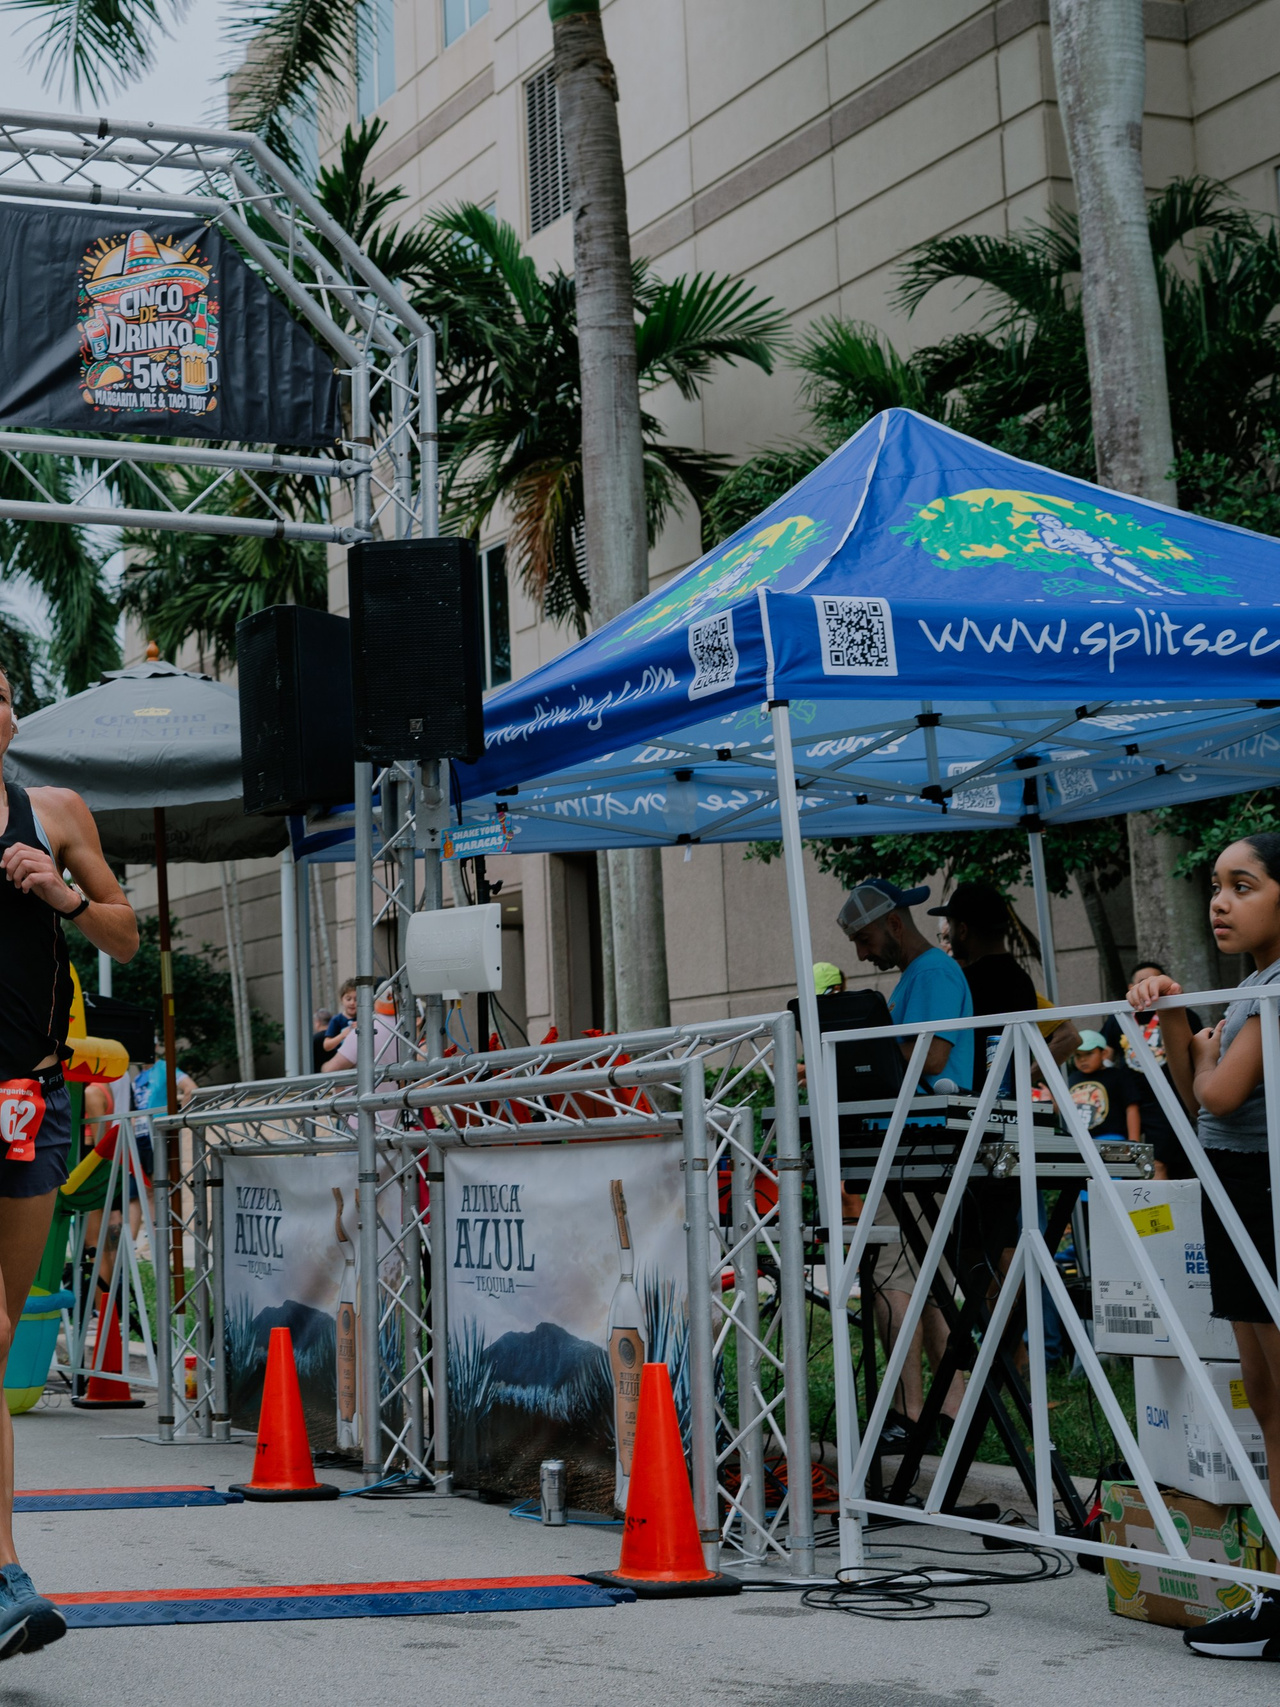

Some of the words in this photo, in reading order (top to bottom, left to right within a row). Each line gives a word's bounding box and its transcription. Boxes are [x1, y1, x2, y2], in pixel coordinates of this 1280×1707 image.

[120, 284, 183, 317] CINCO
[139, 305, 158, 324] DE
[107, 315, 193, 354] DRINKO
[133, 357, 167, 389] 5K
[94, 389, 138, 408] MARGARITA
[139, 392, 156, 408] MILE
[168, 394, 187, 410] TACO
[188, 394, 208, 412] TROT
[68, 723, 231, 739] PREMIER
[94, 714, 207, 726] Corona
[452, 828, 480, 840] SHAKE
[481, 824, 502, 836] YOUR
[454, 836, 503, 852] MARACAS
[236, 1186, 282, 1211] AZTECA
[461, 1184, 521, 1213] AZTECA
[234, 1213, 283, 1258] AZUL
[453, 1218, 535, 1271] AZUL
[476, 1276, 515, 1299] TEQUILA
[1158, 1576, 1199, 1600] BANANAS
